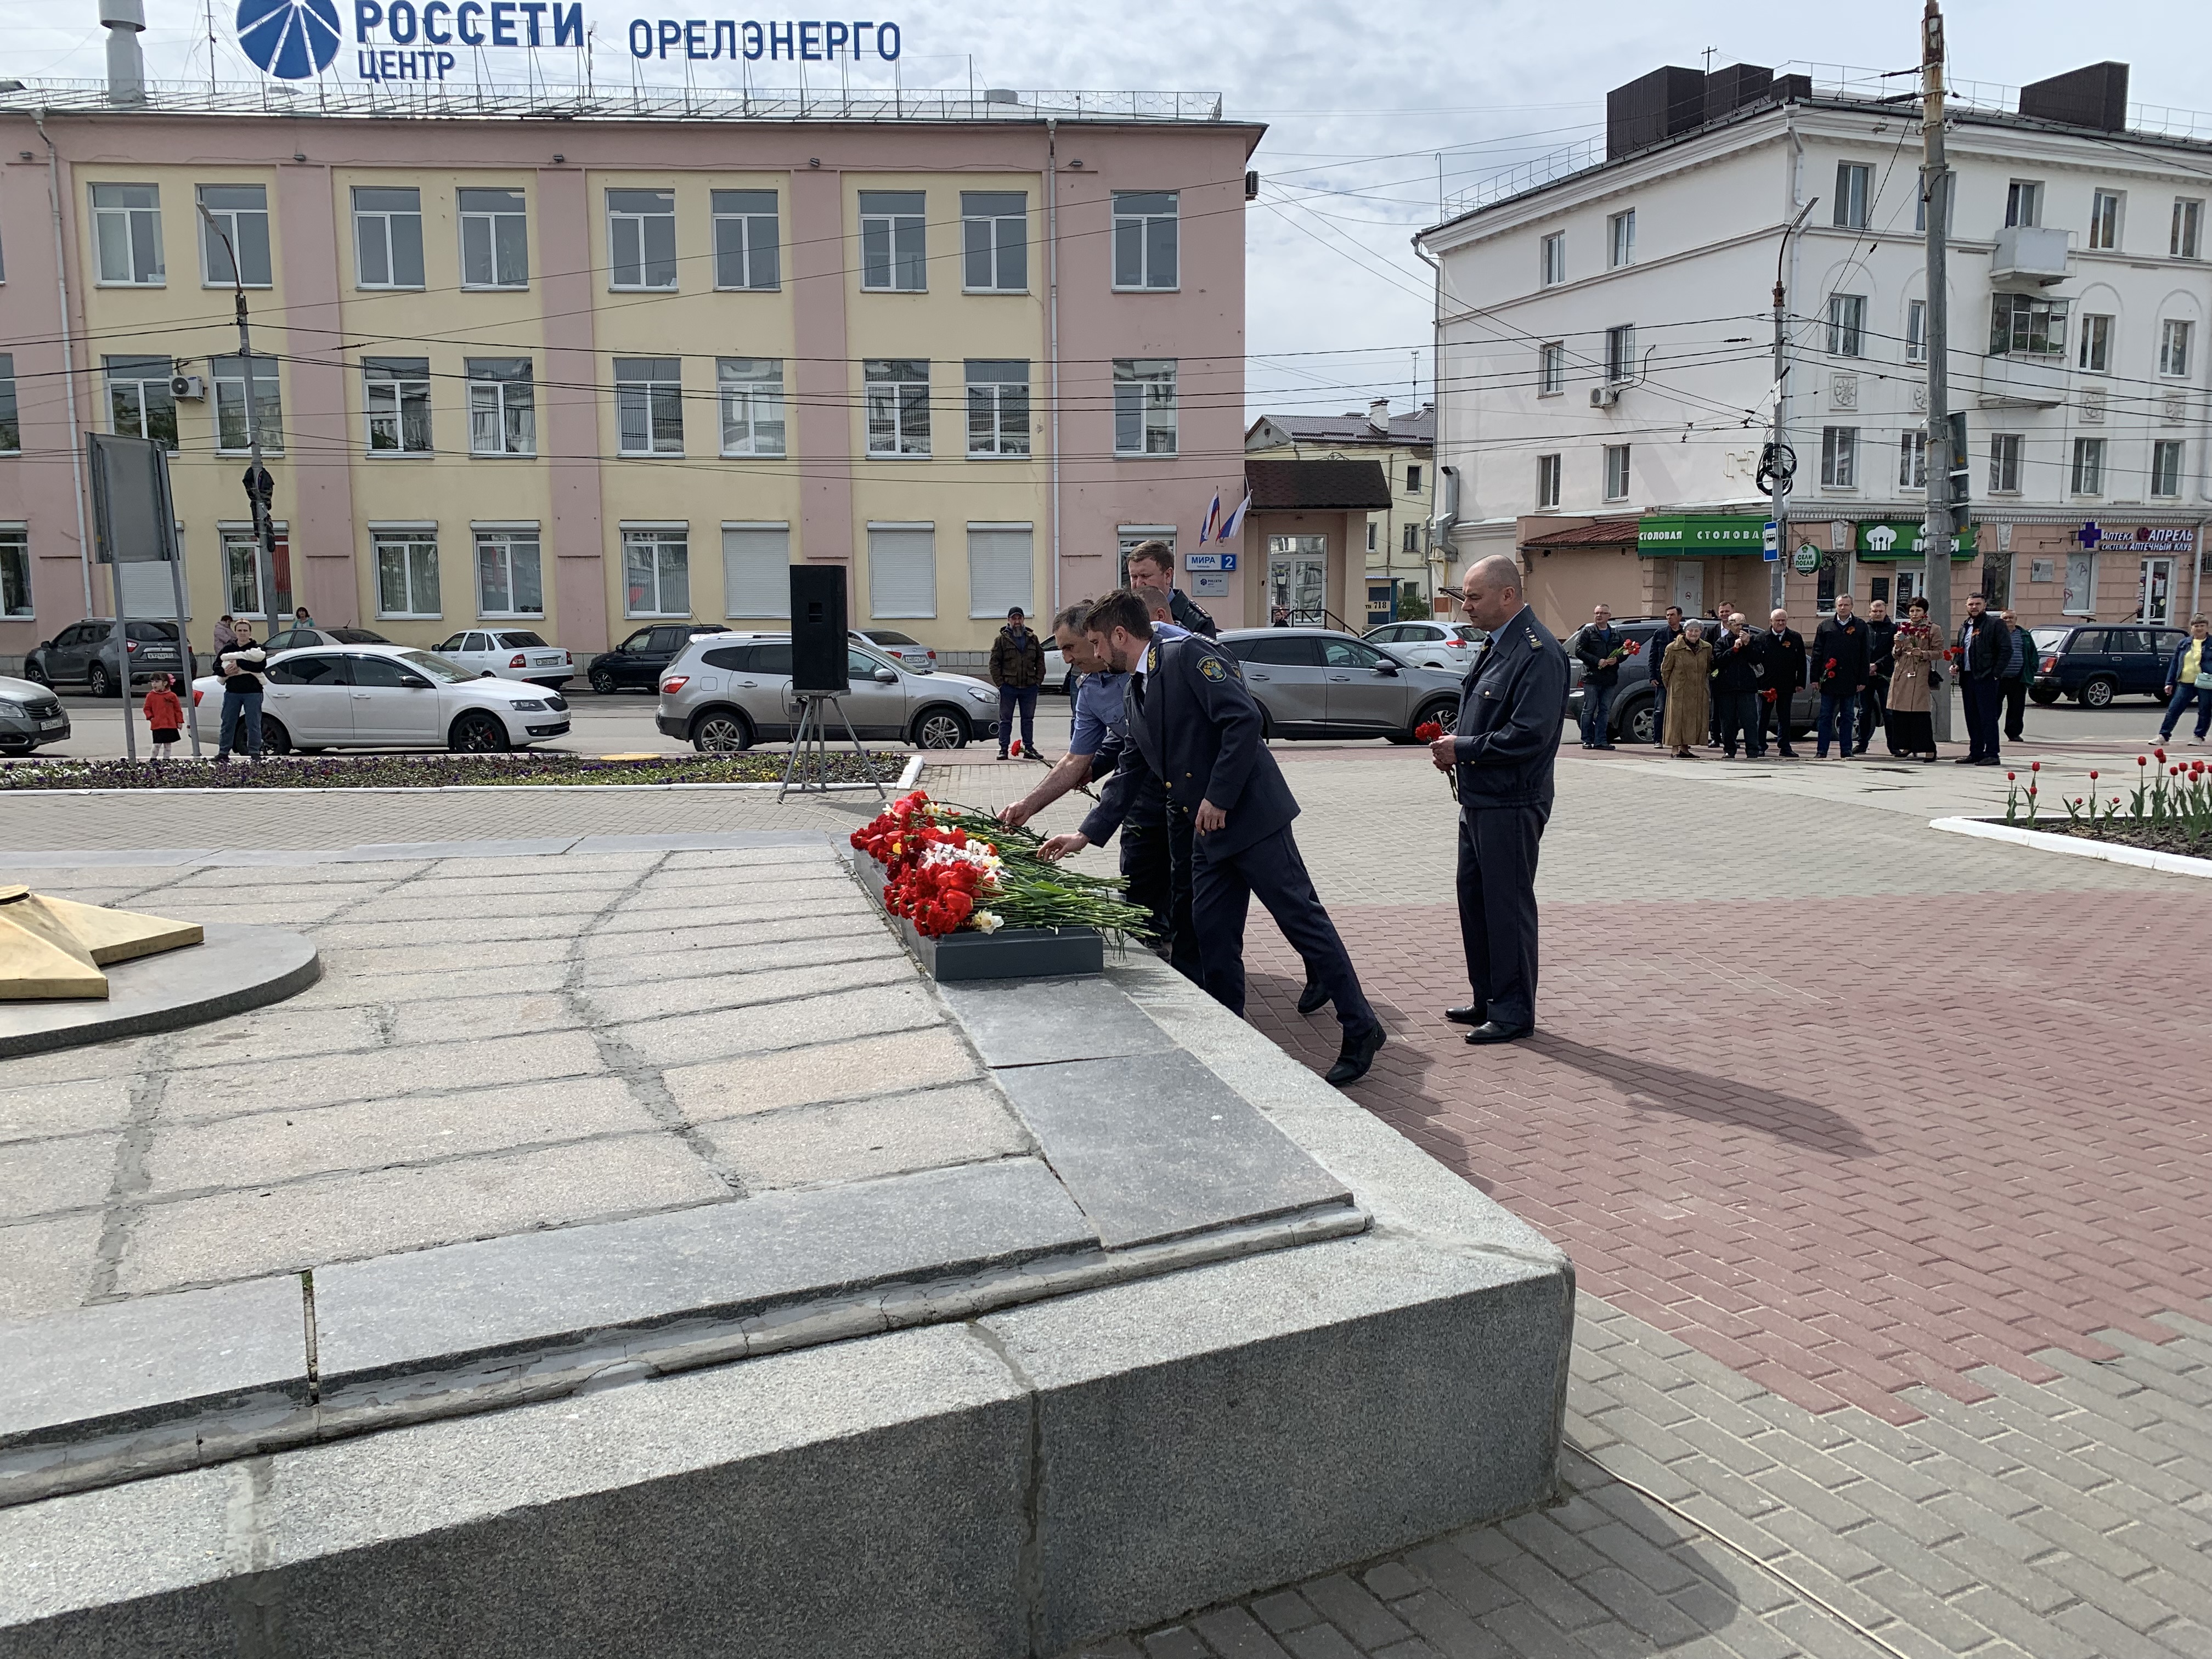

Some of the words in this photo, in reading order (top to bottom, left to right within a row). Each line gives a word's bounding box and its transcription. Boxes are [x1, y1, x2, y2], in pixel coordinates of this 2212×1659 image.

[355, 0, 584, 47] РОССЕТИ
[629, 19, 900, 61] ОРЕЛЭНЕРГО
[358, 50, 455, 83] ЦЕНТР
[1639, 531, 1682, 540] СТОЛОВАЯ
[2103, 532, 2134, 541] АПТЕКА
[2148, 529, 2193, 541] АПРЕЛЬ
[2129, 542, 2171, 551] АПТЕЧНЫЙ
[1225, 556, 1233, 568] 2
